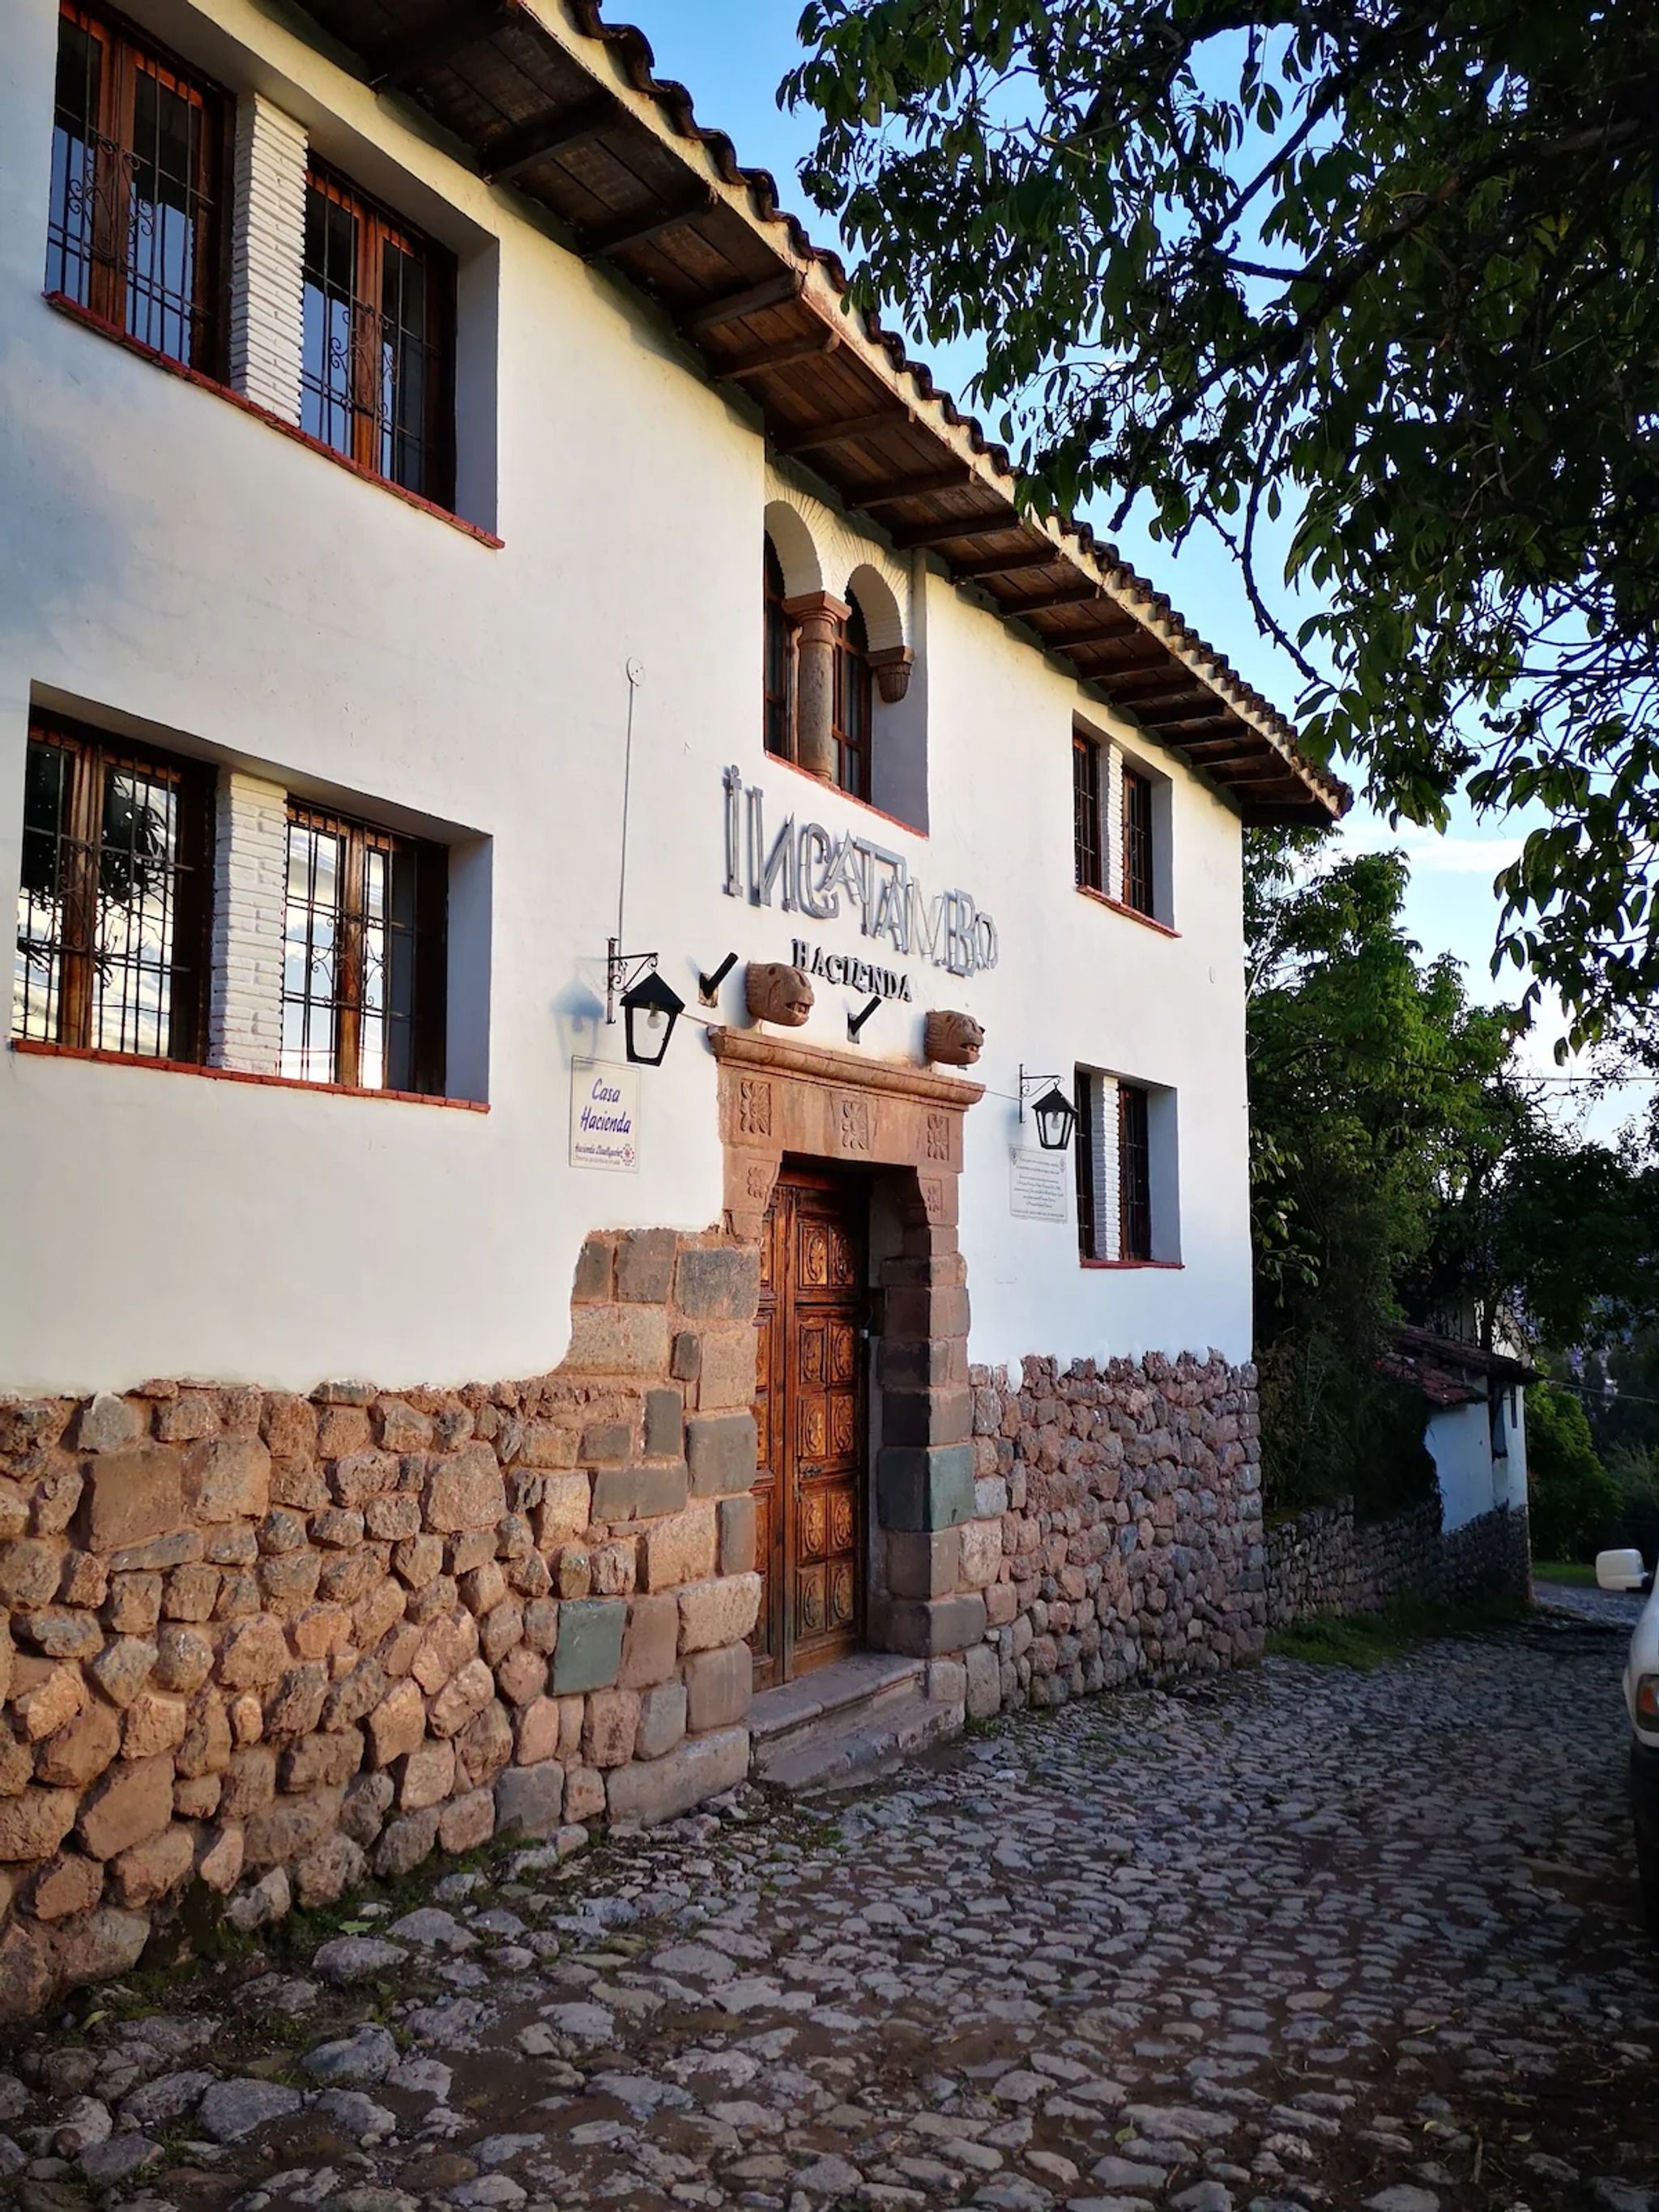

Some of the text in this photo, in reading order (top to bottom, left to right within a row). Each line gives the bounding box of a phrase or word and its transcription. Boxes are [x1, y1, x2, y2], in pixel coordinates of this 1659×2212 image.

[791, 939, 913, 1003] HACIENDA
[591, 1077, 621, 1103] Casa
[580, 1106, 632, 1134] Hacienda
